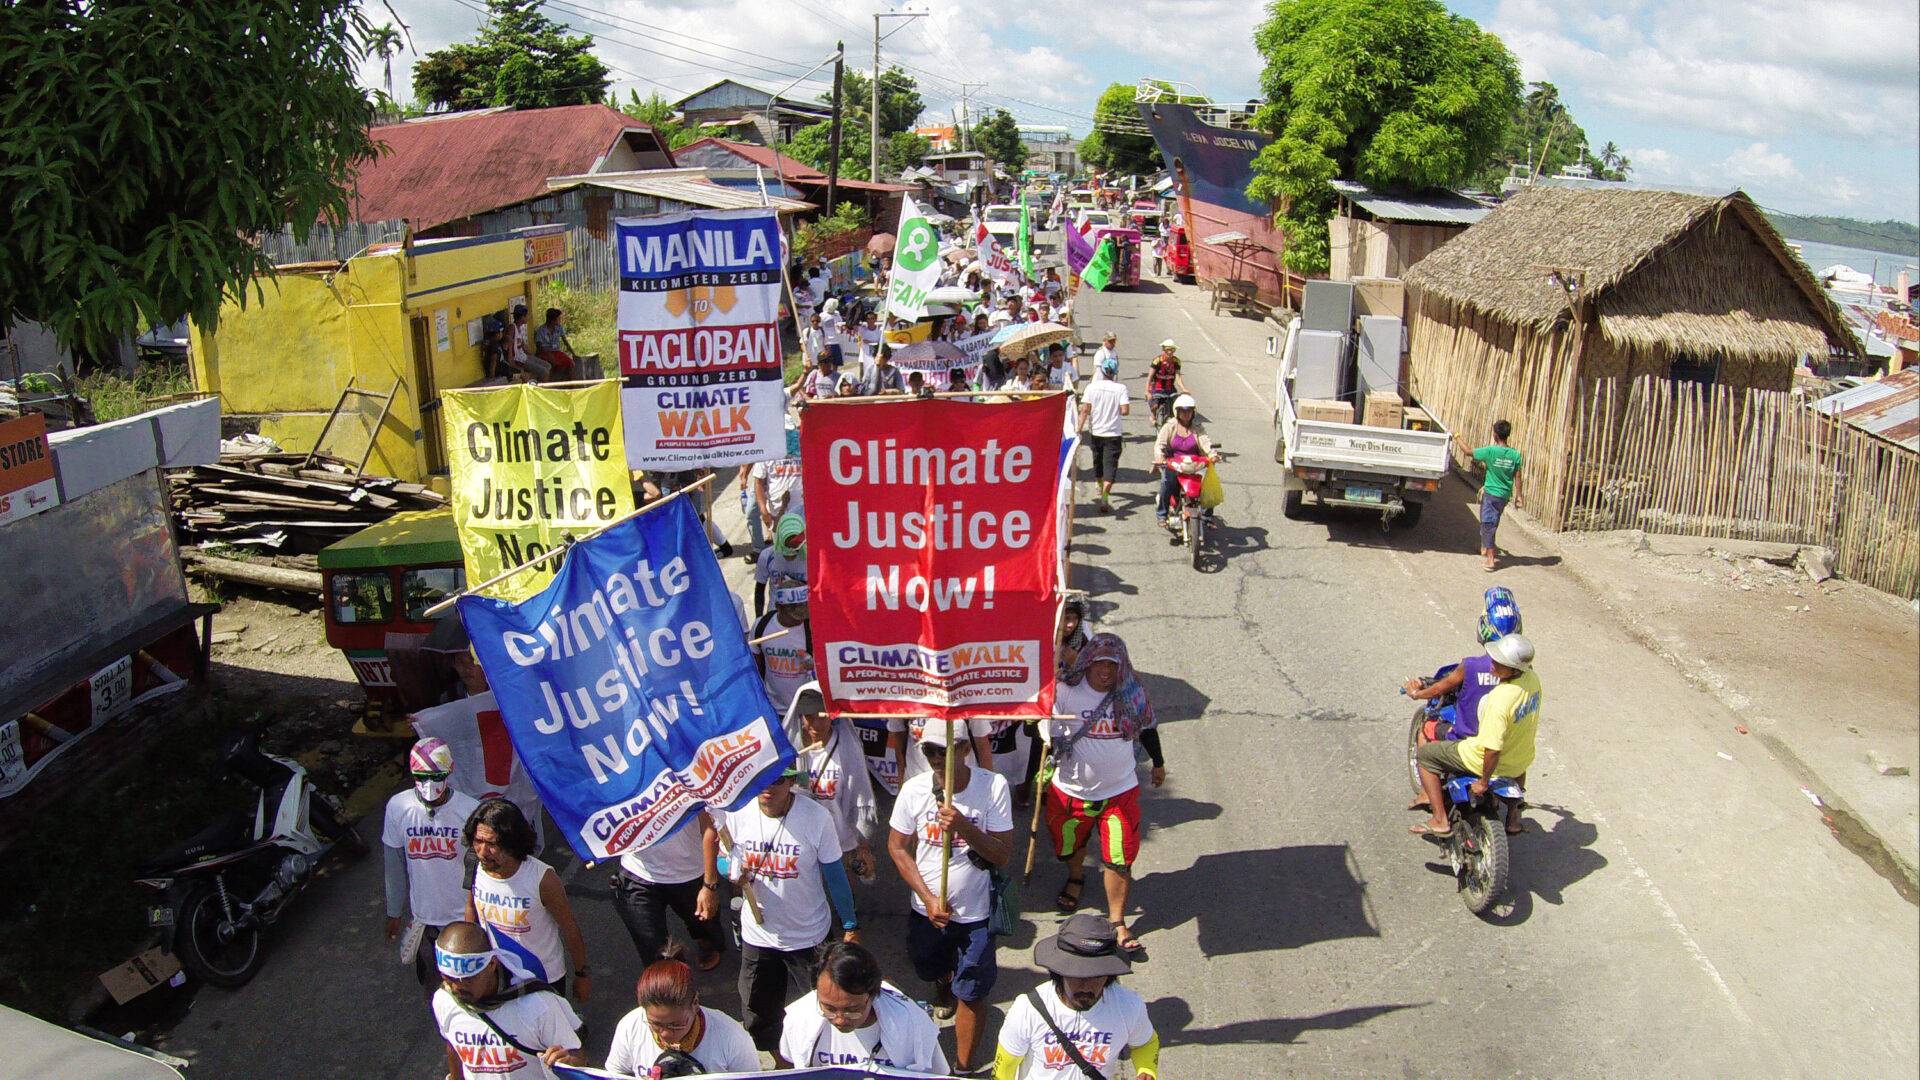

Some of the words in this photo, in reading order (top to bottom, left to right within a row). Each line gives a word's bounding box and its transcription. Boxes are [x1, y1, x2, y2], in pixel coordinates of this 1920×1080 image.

[1213, 136, 1257, 151] JOCELYN
[625, 228, 773, 272] MANILA
[632, 274, 719, 290] KILOMETER
[729, 272, 768, 285] ZERO
[693, 300, 708, 313] TO
[622, 327, 775, 369] TACLOBAN
[647, 374, 710, 386] GROUND
[719, 369, 757, 382] ZERO
[657, 387, 751, 409] CLIMATE
[657, 405, 751, 437] WALK
[0, 436, 44, 470] STORE
[467, 421, 610, 463] Climate
[1349, 439, 1366, 451] Keep
[829, 438, 1032, 486] Climate
[472, 477, 616, 521] Justice
[832, 501, 1031, 550] Justice
[866, 565, 995, 612] Now!
[503, 556, 690, 666] Climate
[117, 660, 126, 676] AT
[768, 657, 805, 672] WAL
[838, 646, 949, 673] CLIMATE
[952, 645, 1026, 669] WALK
[534, 619, 714, 734] Justice
[846, 670, 854, 678] A
[855, 670, 896, 680] PEOPLE'S
[898, 672, 924, 682] WALK
[981, 669, 1022, 679] JUSTICE
[581, 680, 703, 785] Now!
[693, 729, 756, 781] WALK
[593, 772, 695, 841] CLIMATE
[406, 827, 459, 838] CLIMATE
[408, 837, 458, 853] WALK
[745, 840, 800, 856] CLIMATE
[745, 851, 799, 872] WALK
[472, 886, 531, 909] CLIMATE
[456, 1045, 524, 1066] WALK
[1044, 1045, 1110, 1064] WLK
